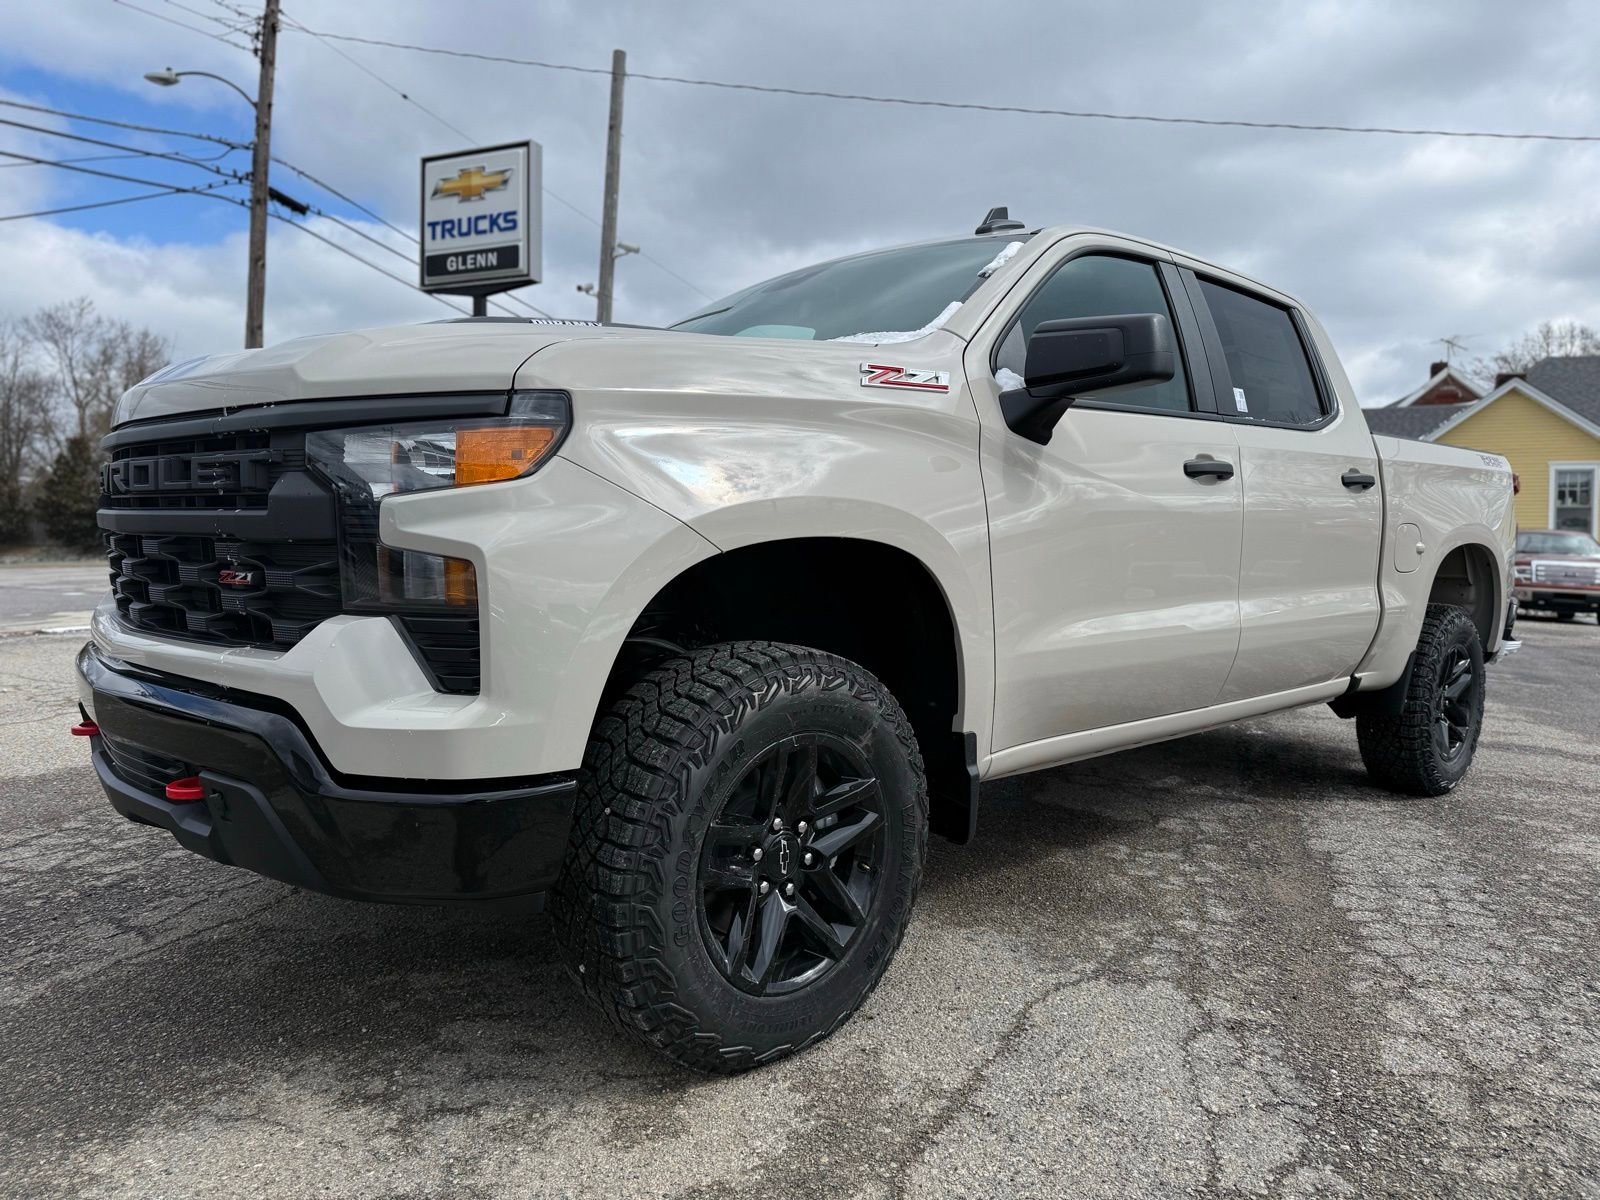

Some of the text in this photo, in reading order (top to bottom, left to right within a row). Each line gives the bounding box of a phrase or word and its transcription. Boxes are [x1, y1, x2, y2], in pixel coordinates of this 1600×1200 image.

[427, 211, 518, 241] TRUCKS
[446, 252, 498, 271] GLENN
[860, 363, 950, 394] Z71
[219, 570, 253, 584] Z71
